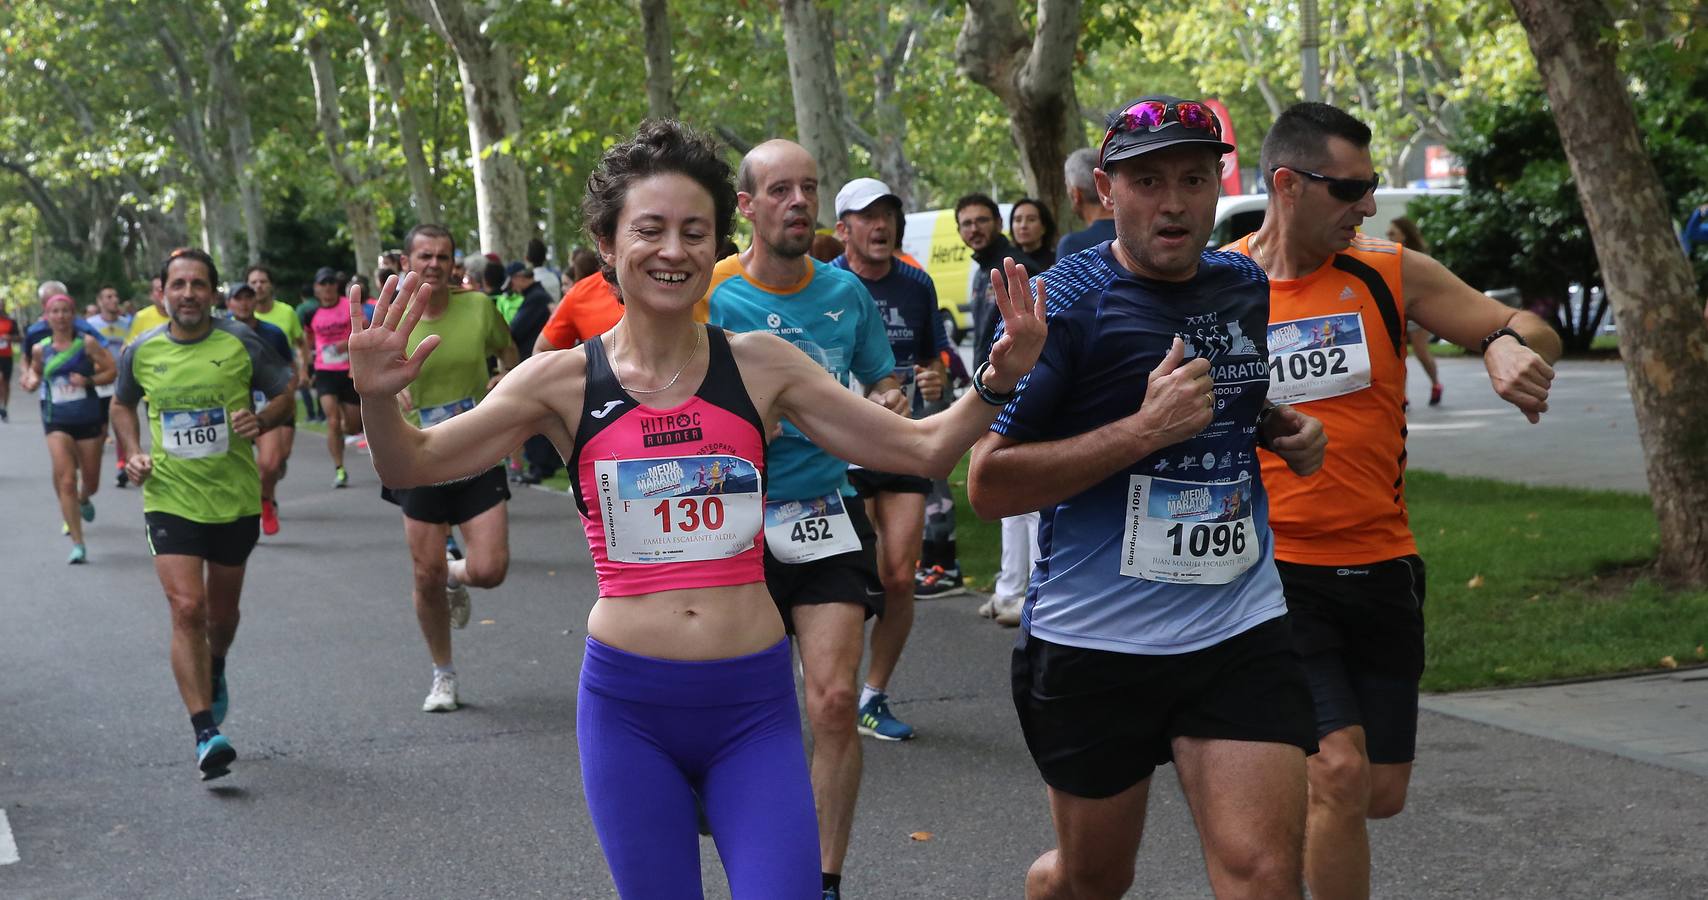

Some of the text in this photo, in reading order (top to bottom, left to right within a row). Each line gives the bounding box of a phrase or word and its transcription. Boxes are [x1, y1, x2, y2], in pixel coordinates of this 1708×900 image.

[931, 245, 966, 264] Hertz
[887, 328, 914, 337] RATÓN
[1269, 348, 1348, 383] 1092
[1213, 386, 1242, 395] ADOLID
[1213, 399, 1225, 410] 19
[173, 427, 217, 446] 1160
[647, 430, 698, 446] RUNNER
[648, 460, 680, 478] MEDIA
[1180, 487, 1210, 501] MEDIA
[601, 473, 617, 547] Guardarropa 130
[624, 500, 632, 513] F
[653, 496, 725, 533] 130
[790, 518, 834, 543] 452
[1127, 484, 1142, 566] Guardarropa 1096
[643, 533, 737, 545] PAMELA ESCALANTE ALDEA
[1166, 522, 1246, 557] 1096
